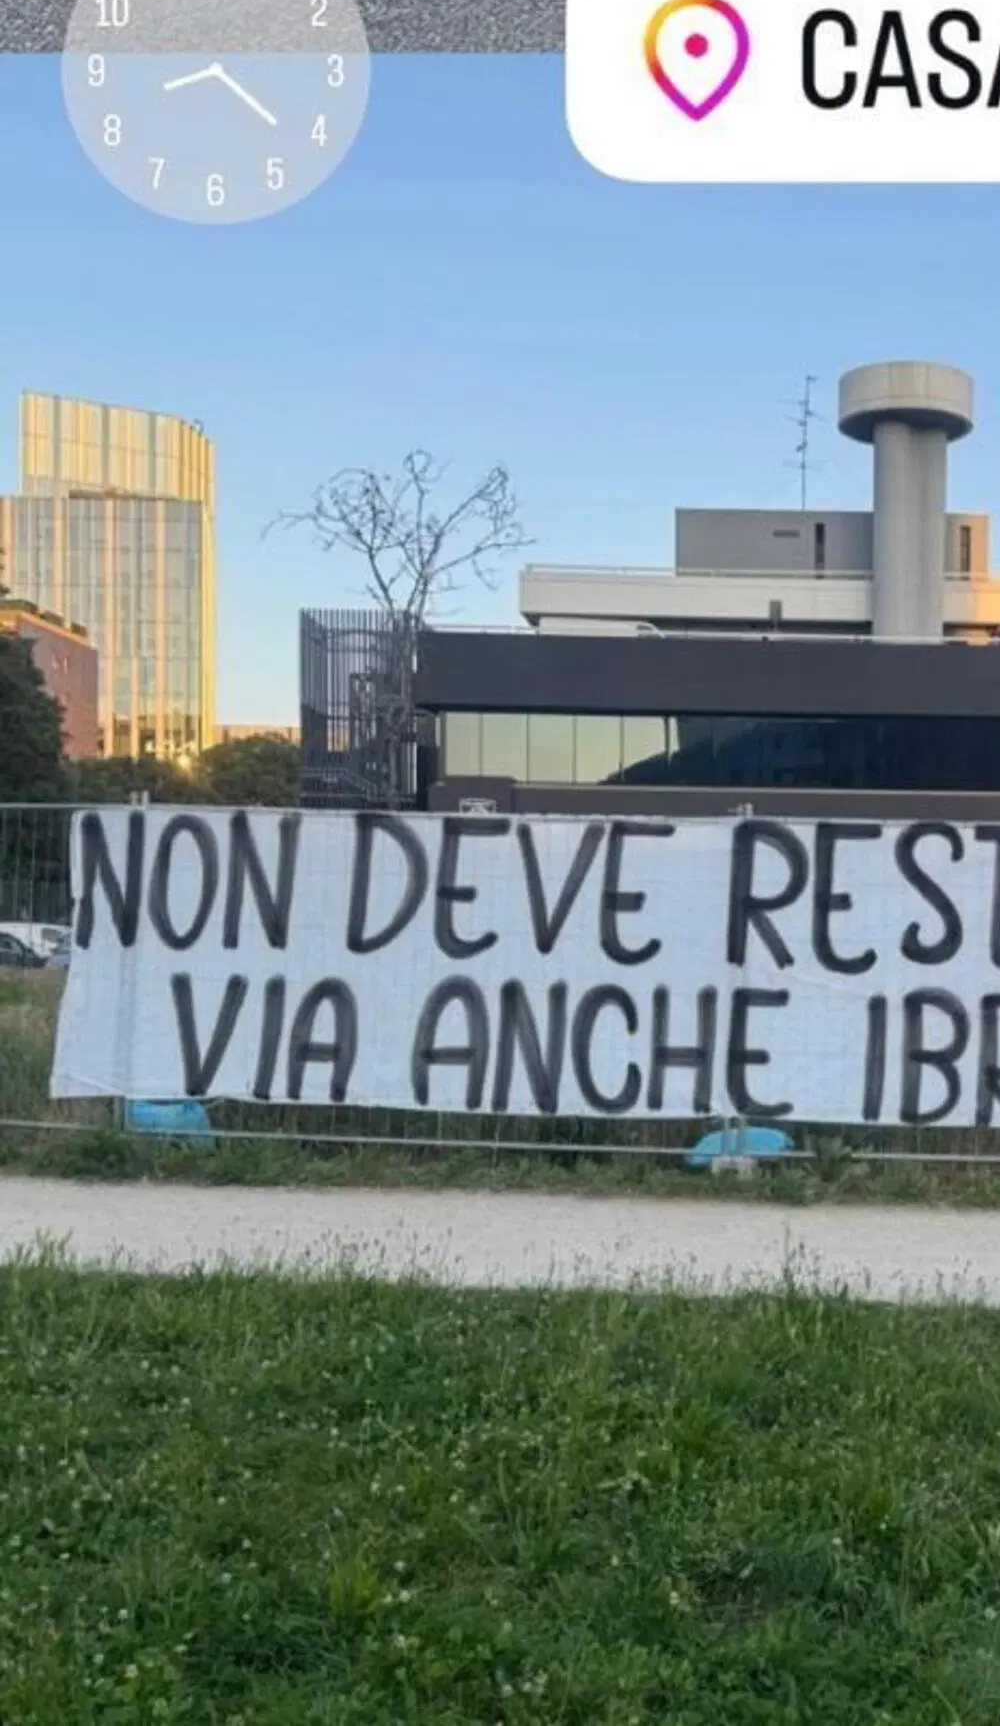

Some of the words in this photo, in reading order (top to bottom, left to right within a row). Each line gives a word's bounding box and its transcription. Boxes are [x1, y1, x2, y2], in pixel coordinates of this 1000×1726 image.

[75, 810, 300, 949] NON
[347, 814, 677, 964] DEVE
[171, 974, 358, 1102] VIA
[411, 975, 793, 1116] ANCHE
